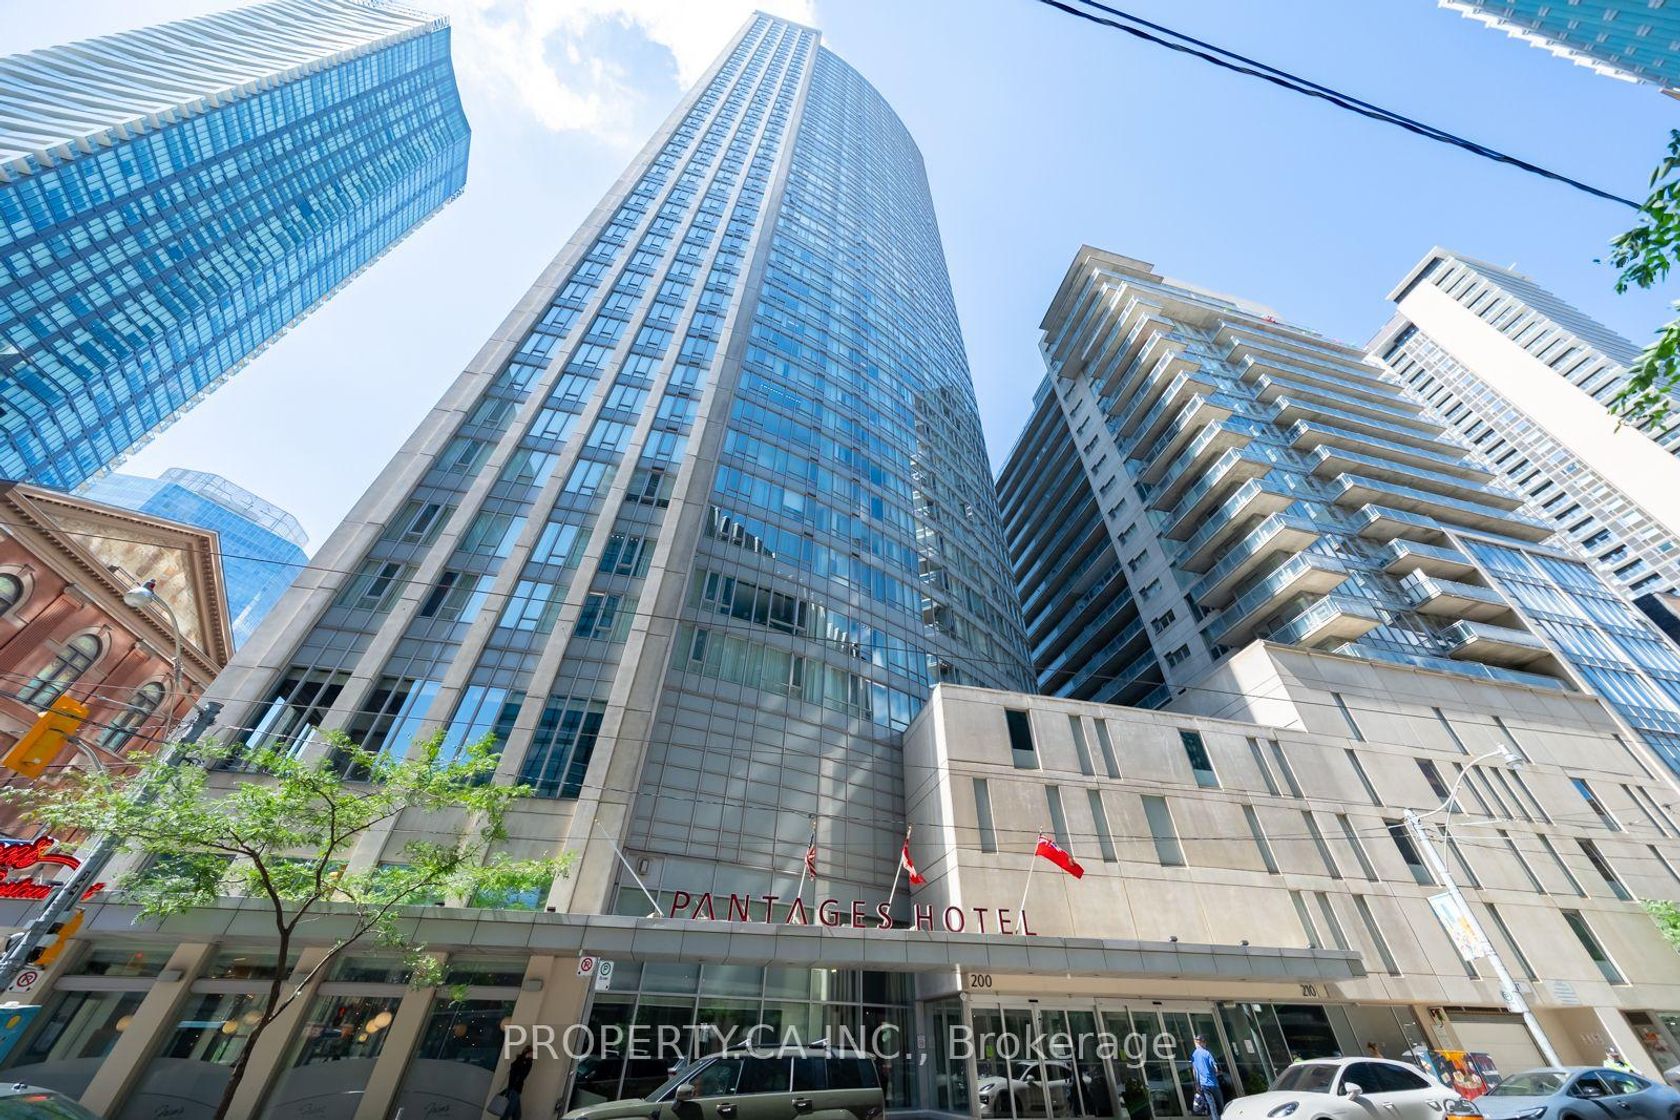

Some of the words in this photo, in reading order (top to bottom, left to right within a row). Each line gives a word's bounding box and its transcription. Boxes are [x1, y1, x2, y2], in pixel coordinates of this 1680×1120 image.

[669, 890, 894, 930] PANTAGES
[914, 904, 1037, 936] HOTEL
[970, 974, 993, 988] 200
[1300, 984, 1317, 997] 210
